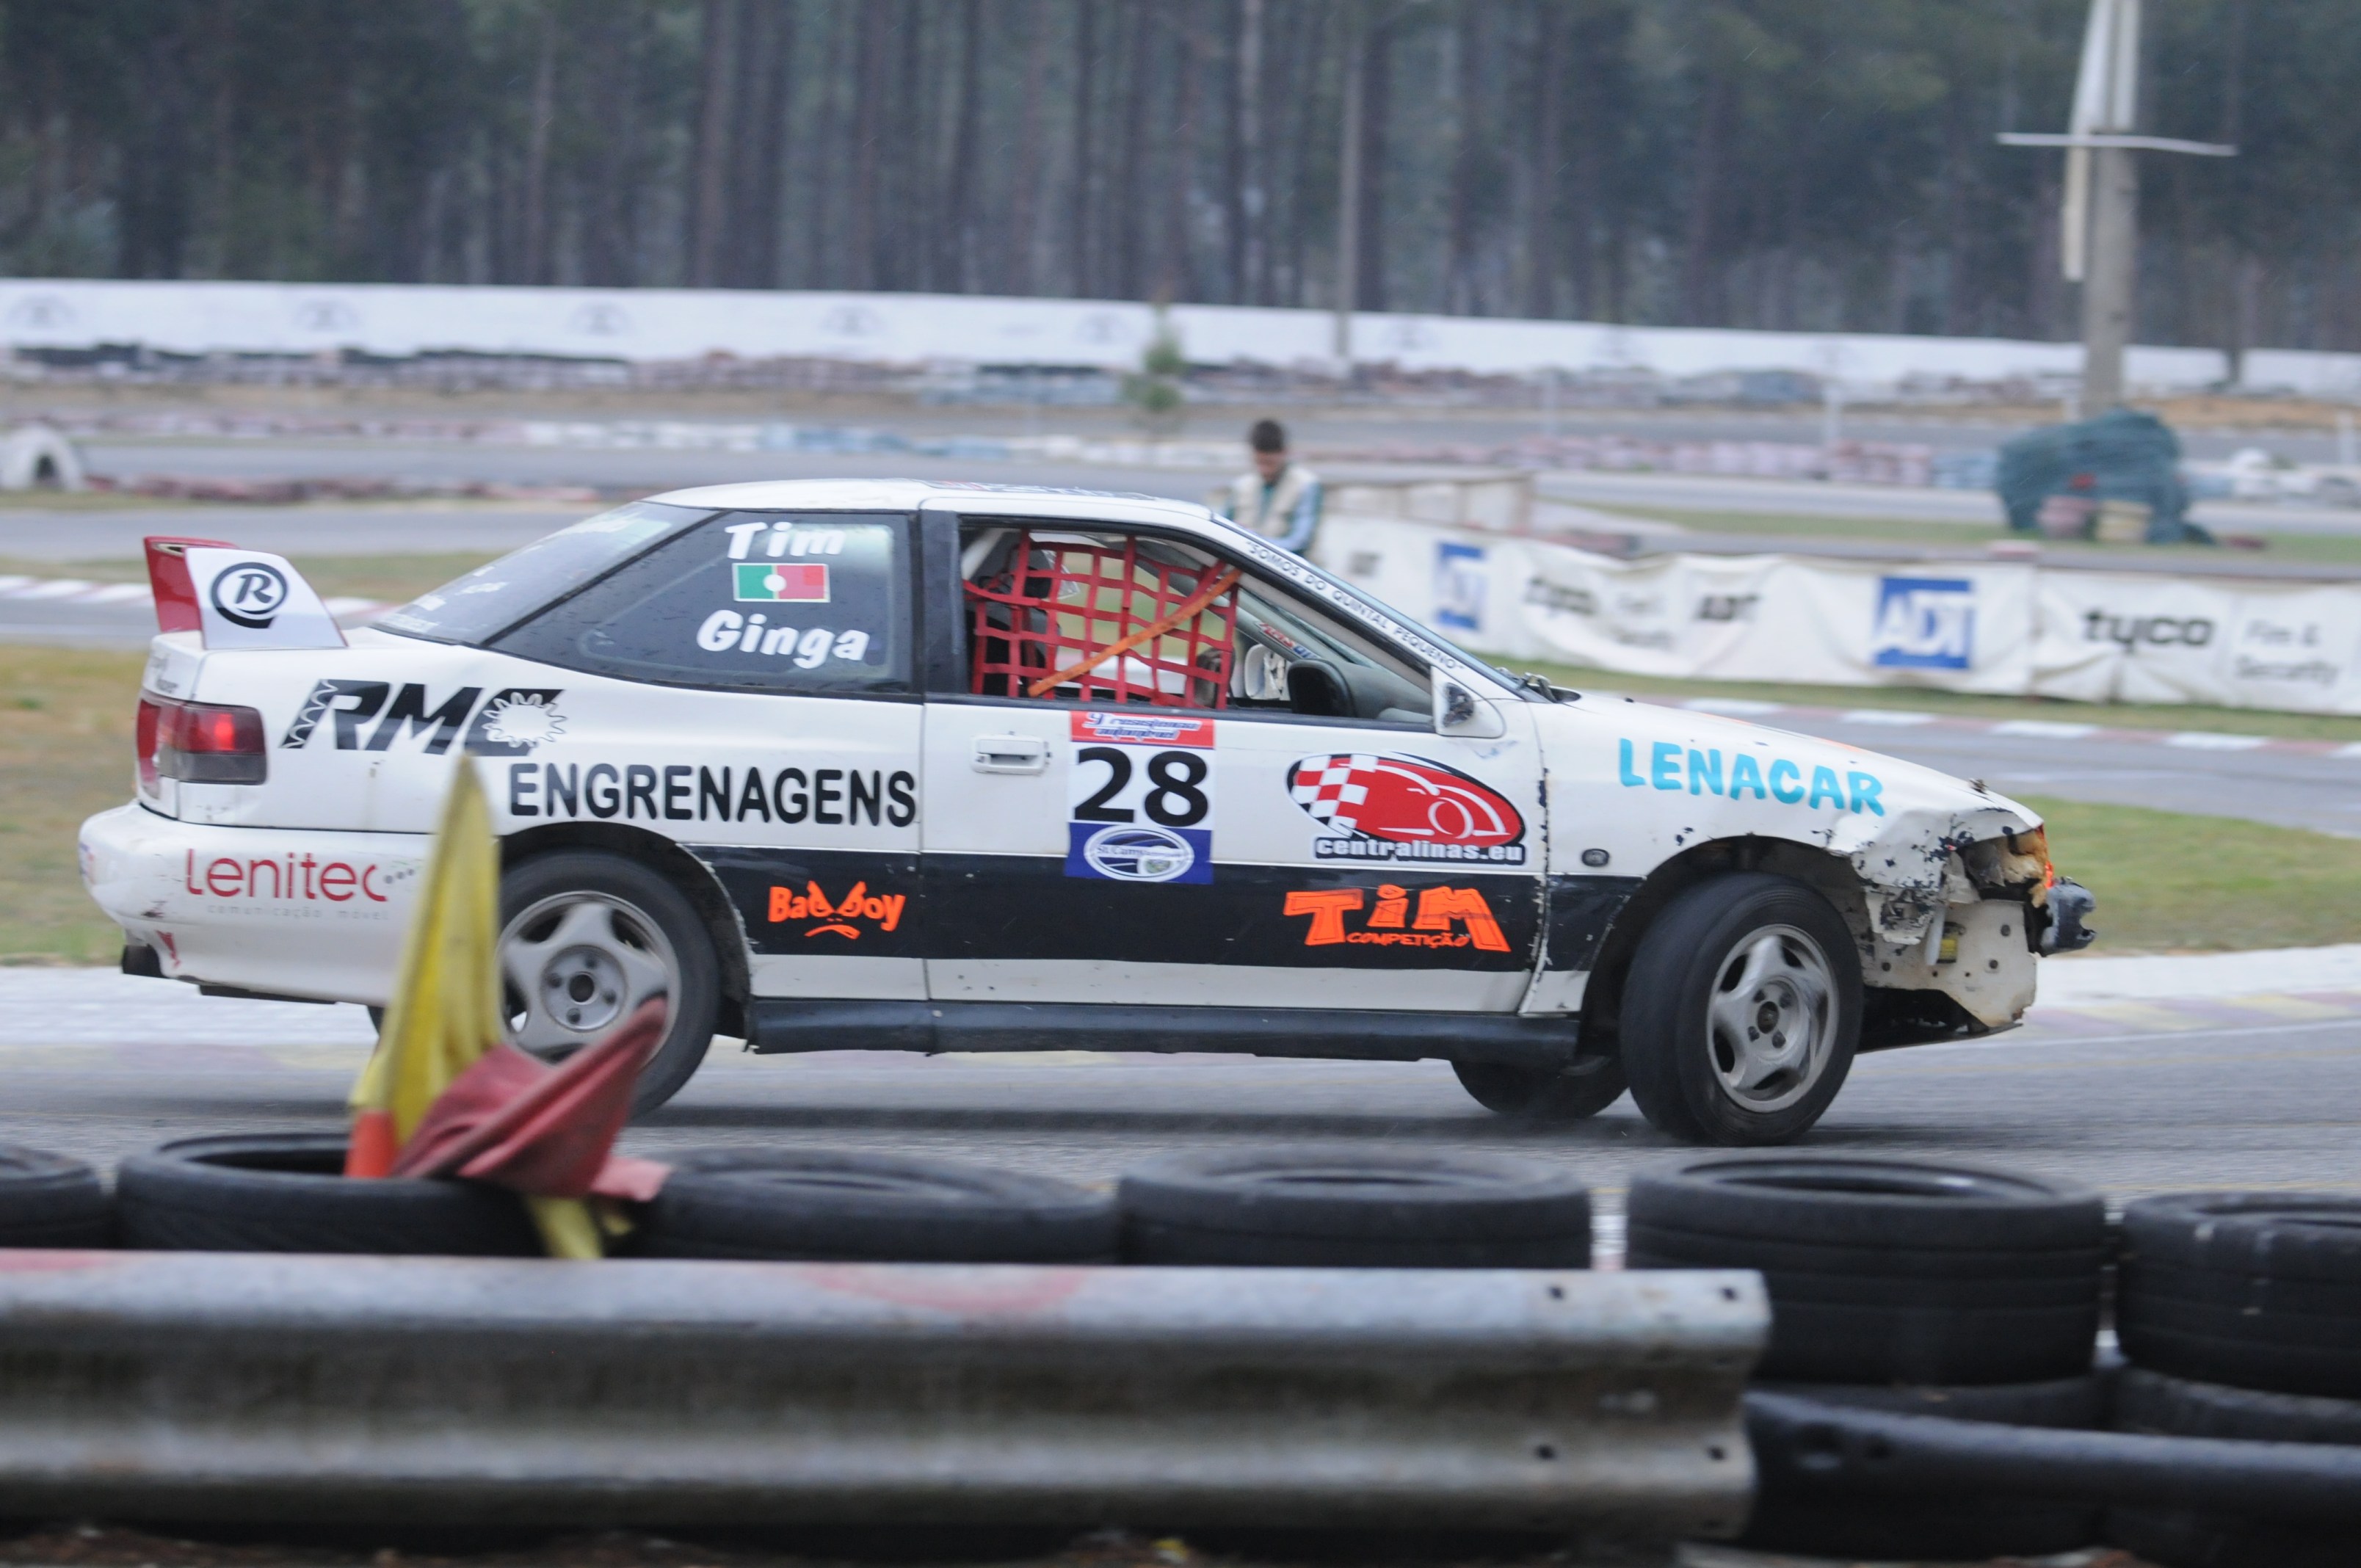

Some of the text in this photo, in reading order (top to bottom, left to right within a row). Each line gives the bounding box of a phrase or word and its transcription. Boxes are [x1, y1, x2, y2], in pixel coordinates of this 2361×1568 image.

[725, 521, 846, 560] Tim
[1305, 575, 1327, 591] DO
[1332, 590, 1388, 630] QUINTAL
[696, 609, 870, 669] Ginga
[2083, 609, 2214, 654] tyco
[508, 763, 917, 828] ENGRENAGENS
[1073, 747, 1210, 828] 28
[1618, 738, 1885, 817] LENACAR
[1315, 839, 1523, 861] centralinas.eu
